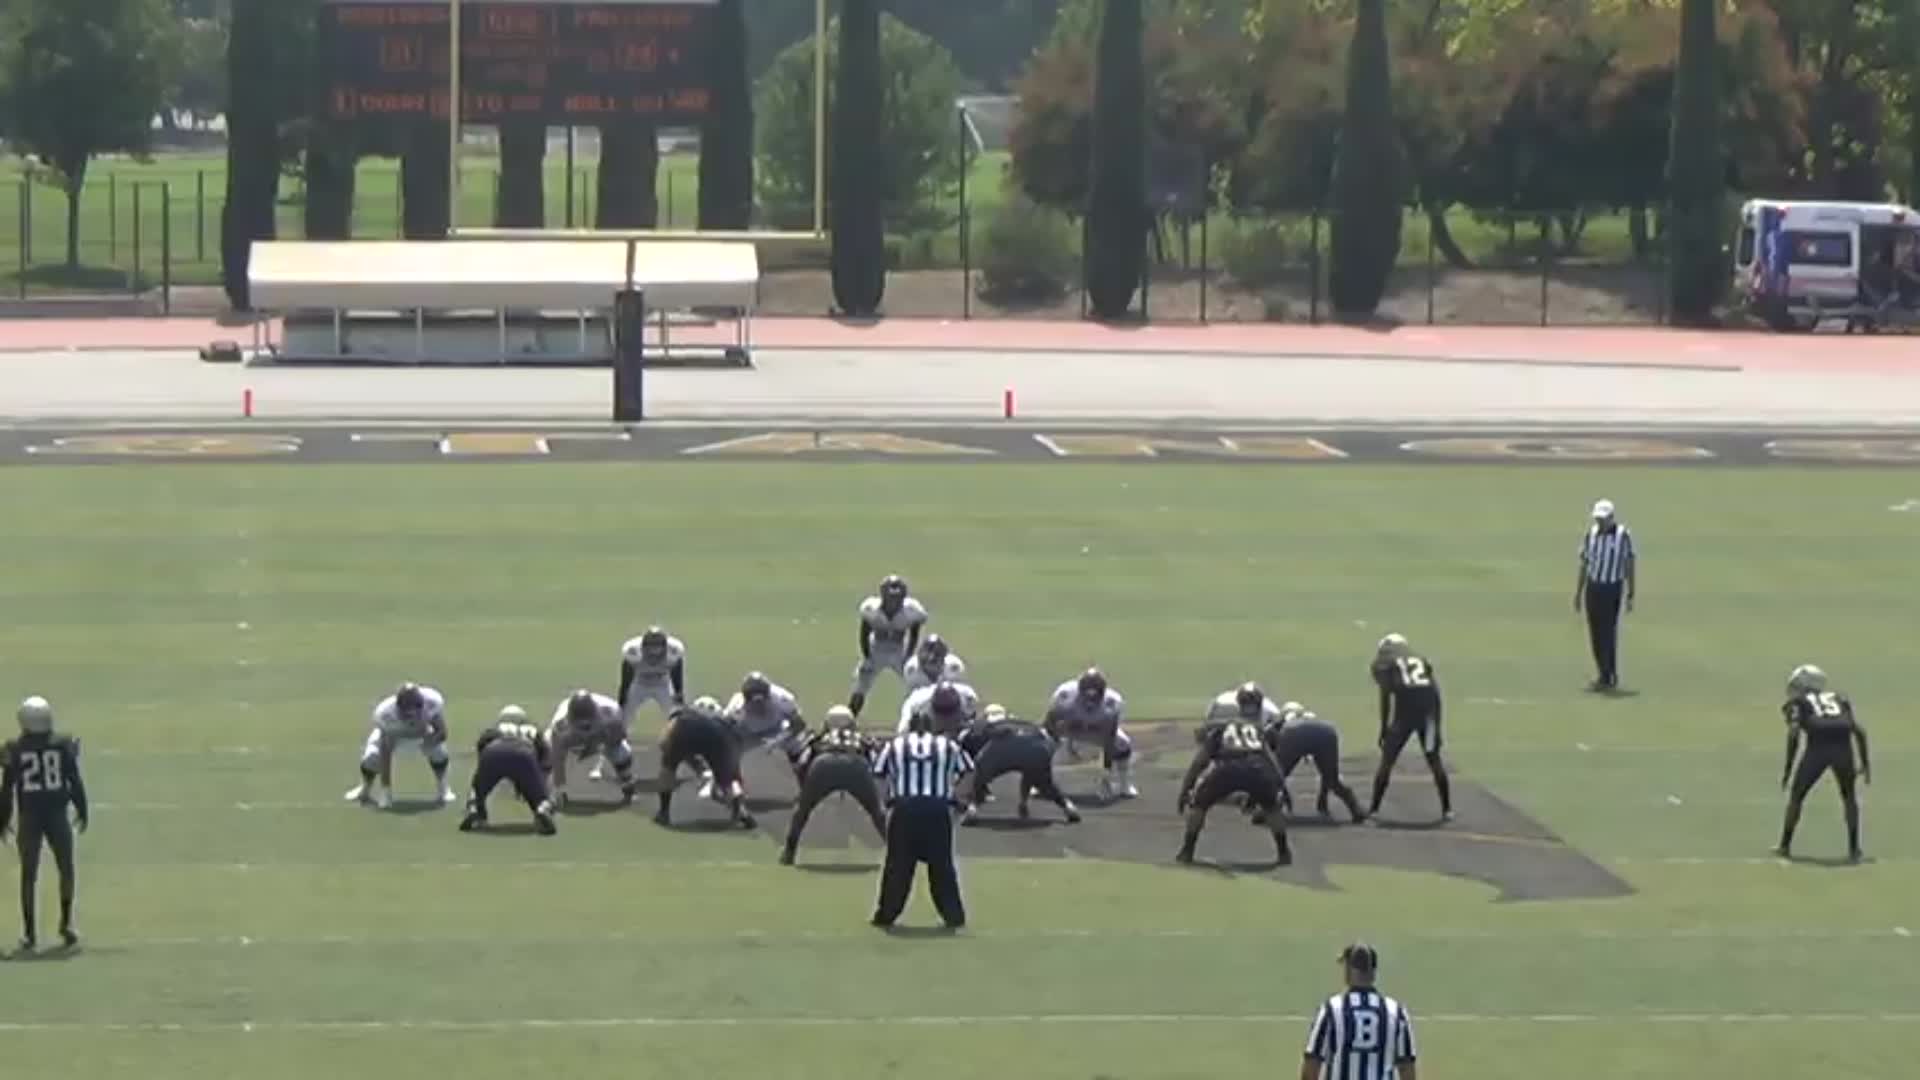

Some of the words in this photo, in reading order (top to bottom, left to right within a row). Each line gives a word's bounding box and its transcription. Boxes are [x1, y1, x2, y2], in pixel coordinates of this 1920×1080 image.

[1395, 655, 1431, 686] 12
[1805, 690, 1842, 718] 15
[1223, 722, 1263, 750] 40
[20, 749, 63, 792] 28
[1351, 1009, 1381, 1049] B
